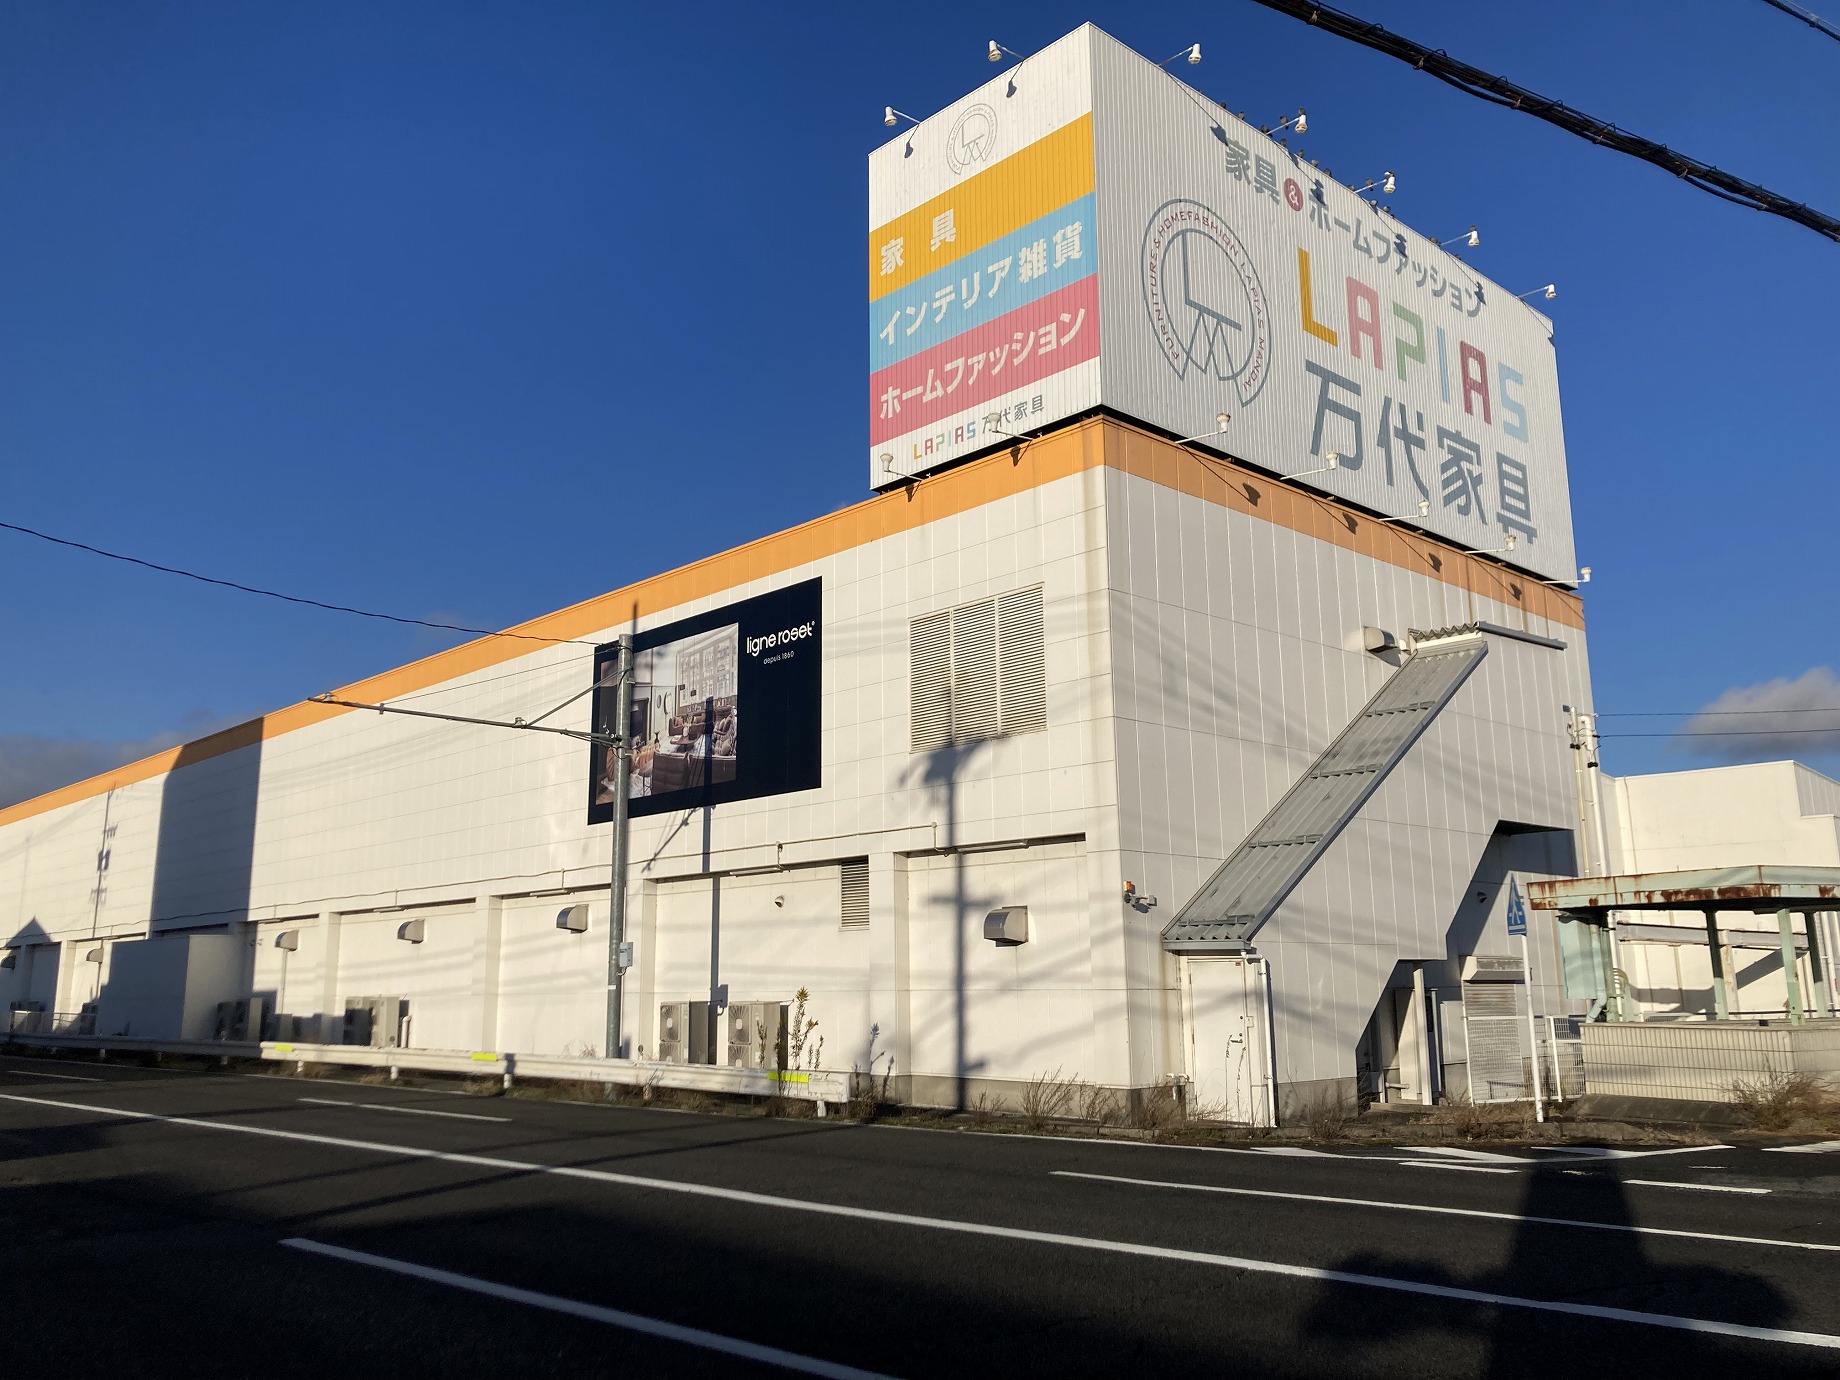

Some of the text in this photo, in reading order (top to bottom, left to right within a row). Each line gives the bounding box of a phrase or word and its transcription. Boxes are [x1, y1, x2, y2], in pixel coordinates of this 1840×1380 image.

[880, 208, 956, 277] 家具
[879, 220, 1084, 346] インテリア雑貨
[1240, 262, 1265, 329] LAPIAS
[879, 308, 1086, 420] ホームファッション
[1243, 336, 1265, 393] MANDAI
[1298, 247, 1530, 444] LAPIAS
[913, 421, 977, 460] LAPIAS
[1305, 359, 1538, 545] 万代家具
[746, 634, 777, 657] ligne
[763, 655, 780, 664] depuis
